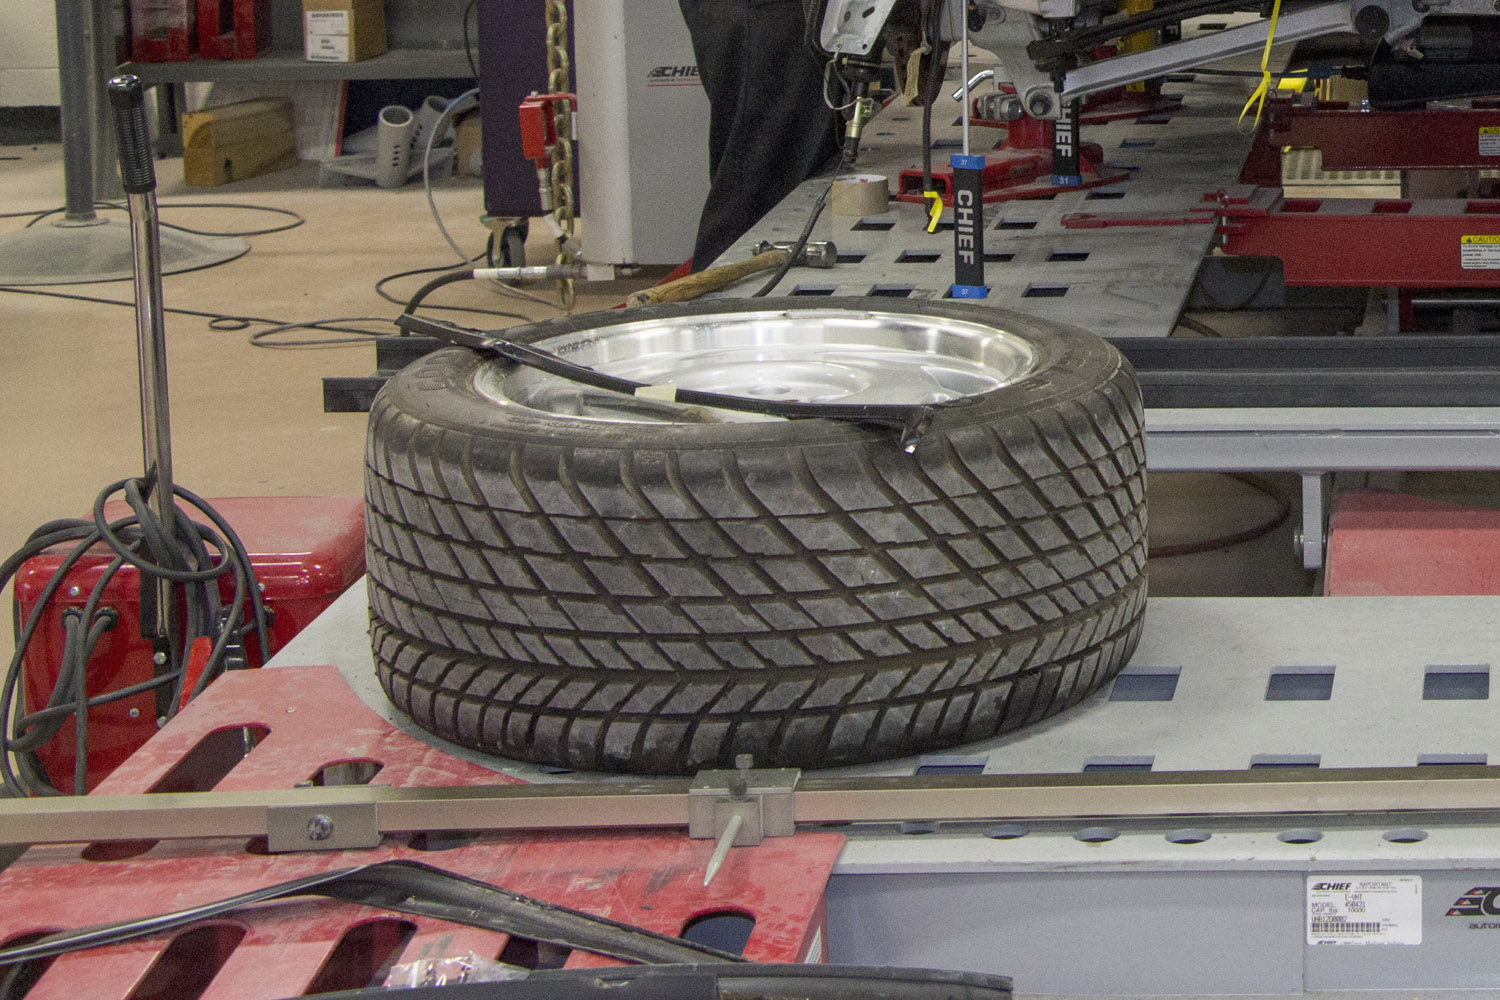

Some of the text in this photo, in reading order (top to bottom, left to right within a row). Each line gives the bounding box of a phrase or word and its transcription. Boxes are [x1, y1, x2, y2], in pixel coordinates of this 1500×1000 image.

[656, 66, 700, 77] CHIE
[957, 190, 975, 265] CHIEF
[1317, 882, 1352, 891] CHIEF
